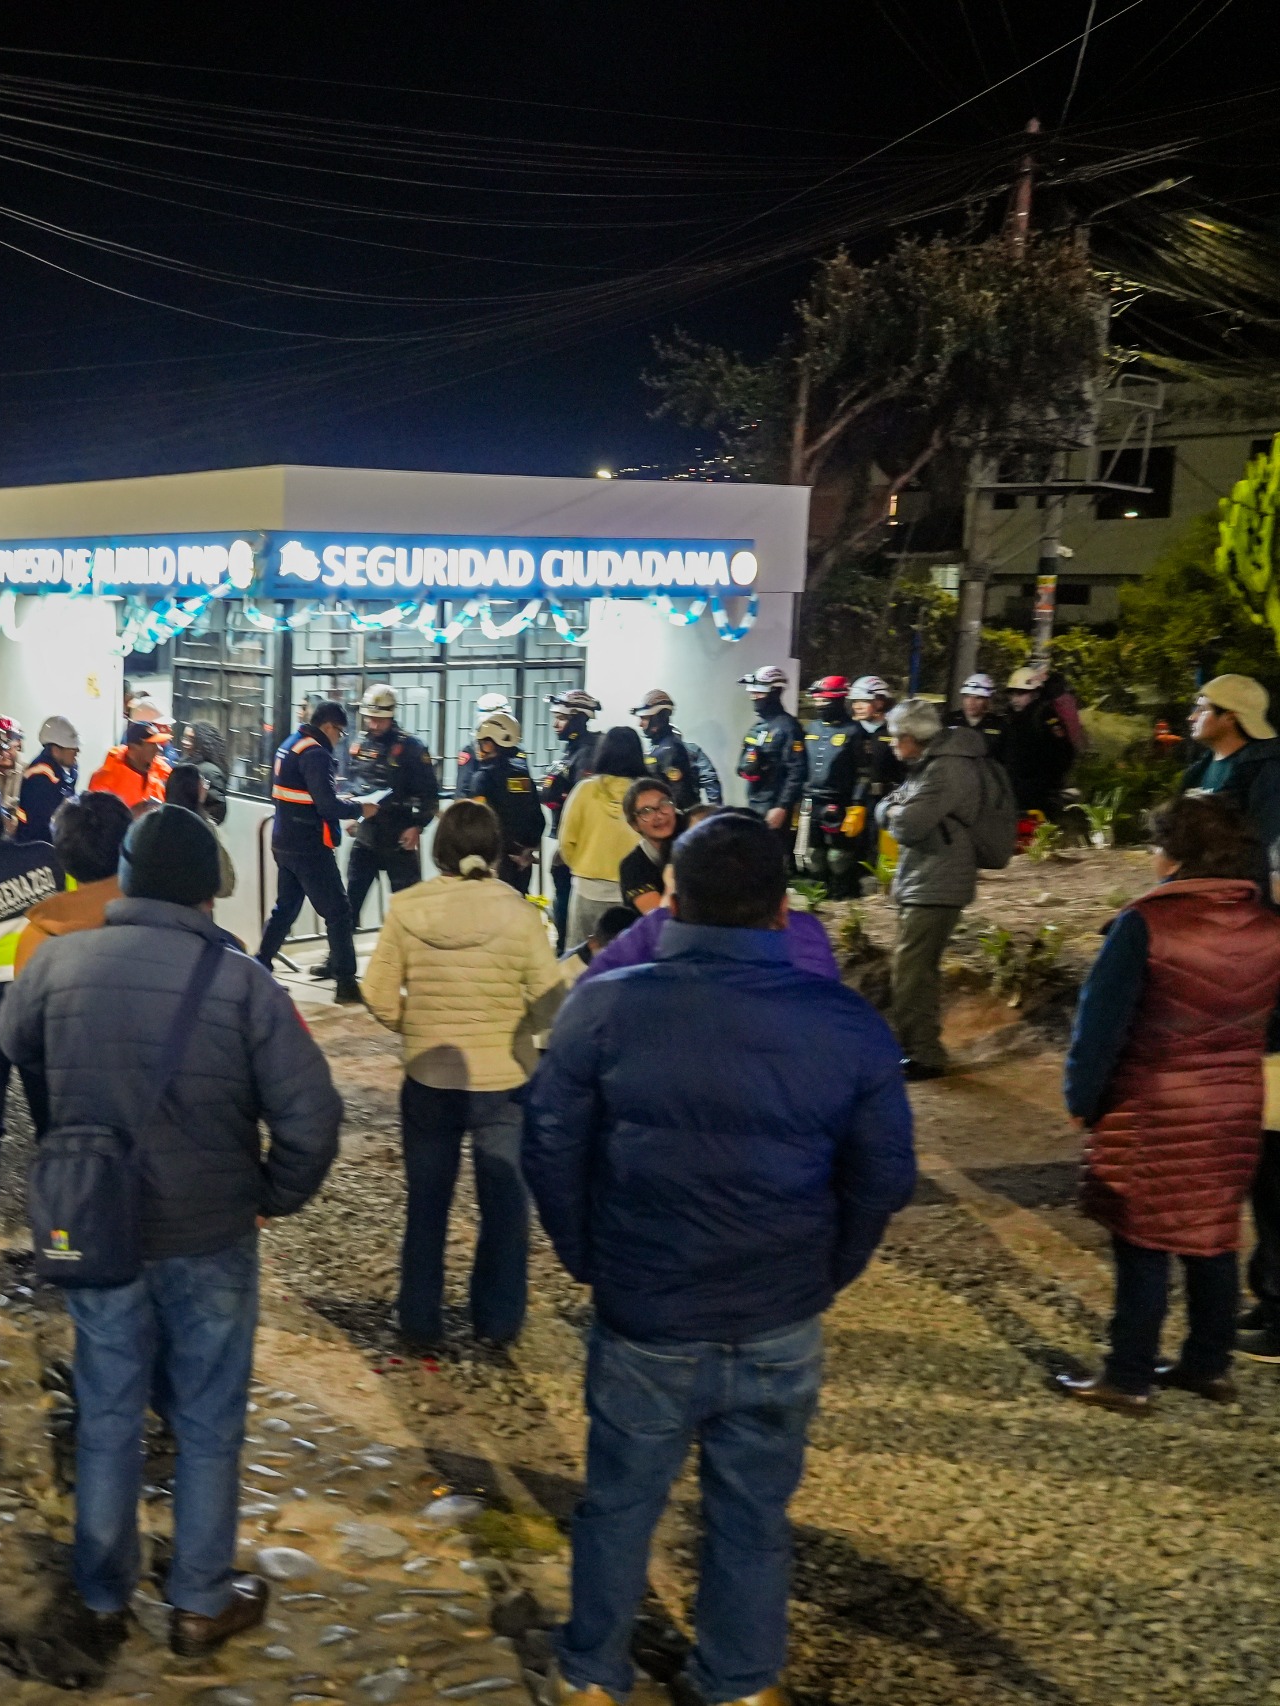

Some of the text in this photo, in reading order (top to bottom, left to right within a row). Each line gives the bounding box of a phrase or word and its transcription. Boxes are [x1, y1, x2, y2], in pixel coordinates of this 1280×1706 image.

[63, 548, 91, 583] DE
[322, 546, 730, 587] SEGURIDAD CIUDADANA
